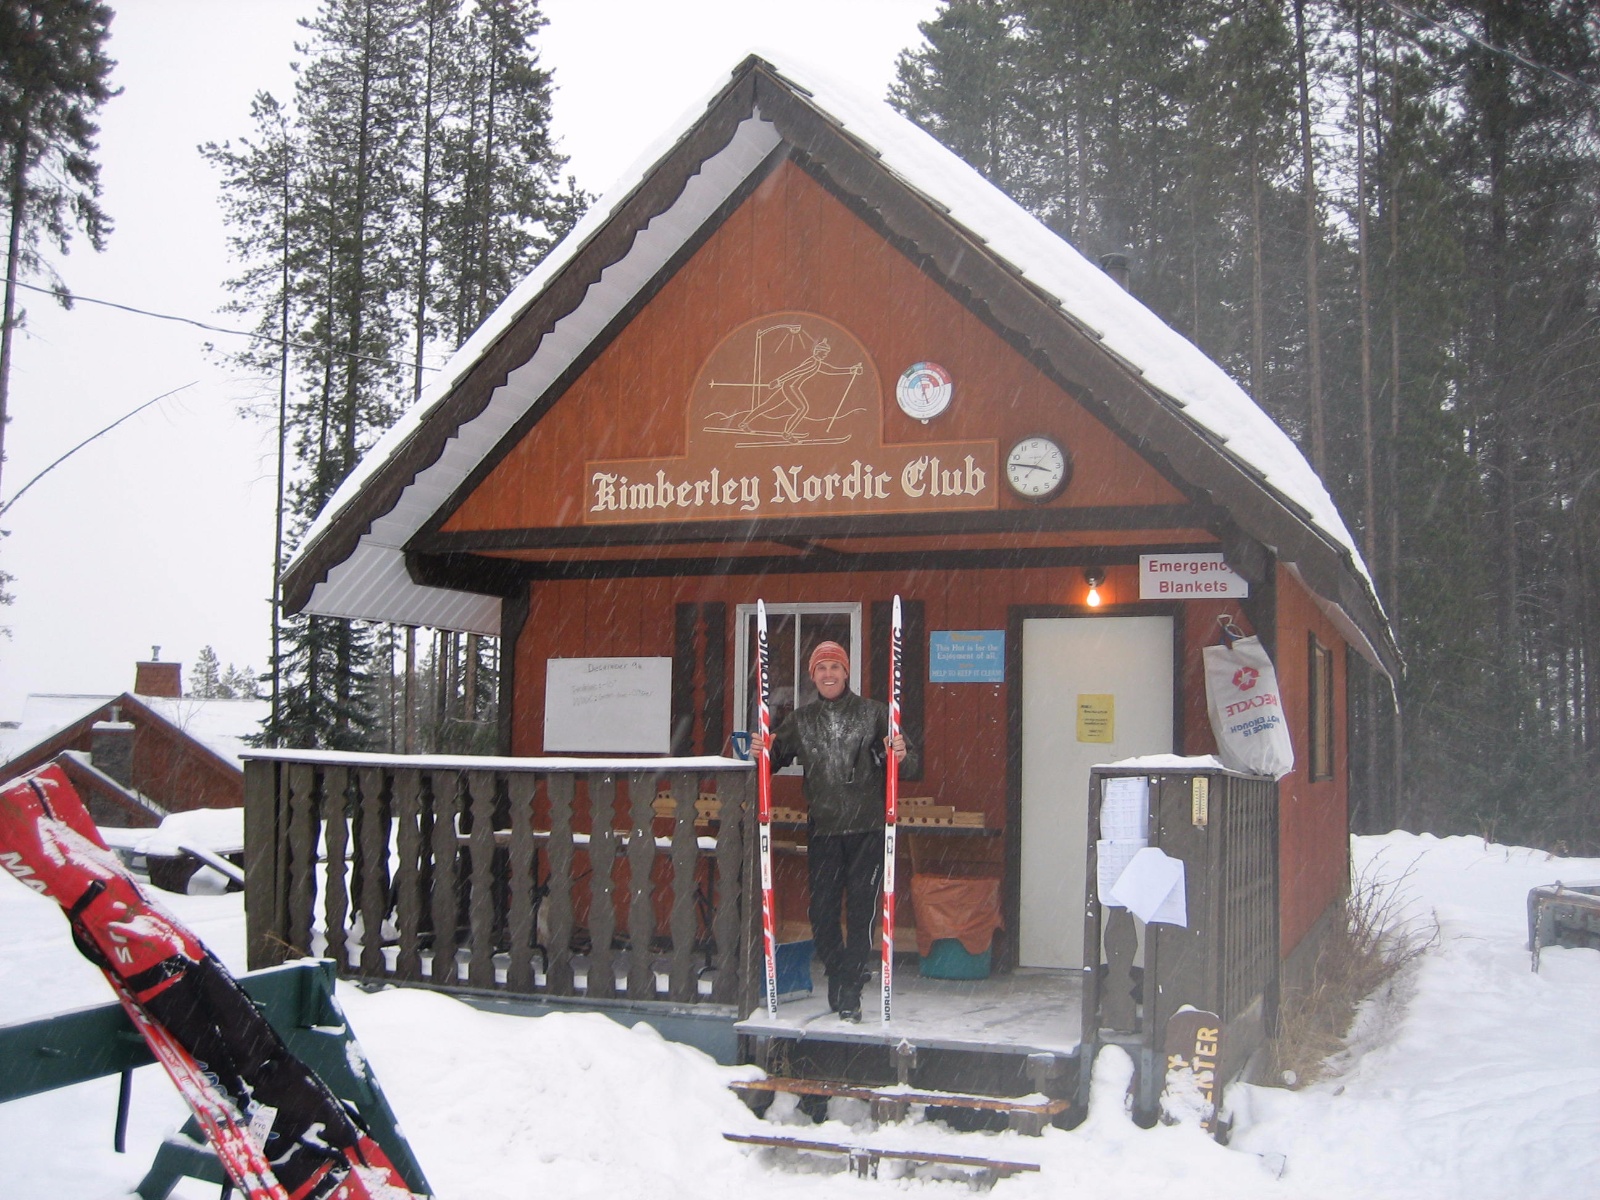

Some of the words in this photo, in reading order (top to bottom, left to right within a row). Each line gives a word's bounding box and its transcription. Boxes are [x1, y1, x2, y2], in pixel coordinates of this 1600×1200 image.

[590, 467, 760, 513] Kimberley
[770, 459, 893, 504] Nordic
[900, 454, 986, 498] Club
[1160, 581, 1227, 593] Blankets
[952, 643, 964, 651] Hut
[975, 643, 985, 651] for
[988, 643, 998, 651] the
[759, 629, 769, 706] ATOMIC
[893, 626, 901, 702] ATOMIC
[1225, 693, 1278, 717] RECYCLE
[1230, 716, 1266, 733] ENOUGH
[1243, 729, 1252, 737] IS
[1253, 723, 1274, 734] ONCE
